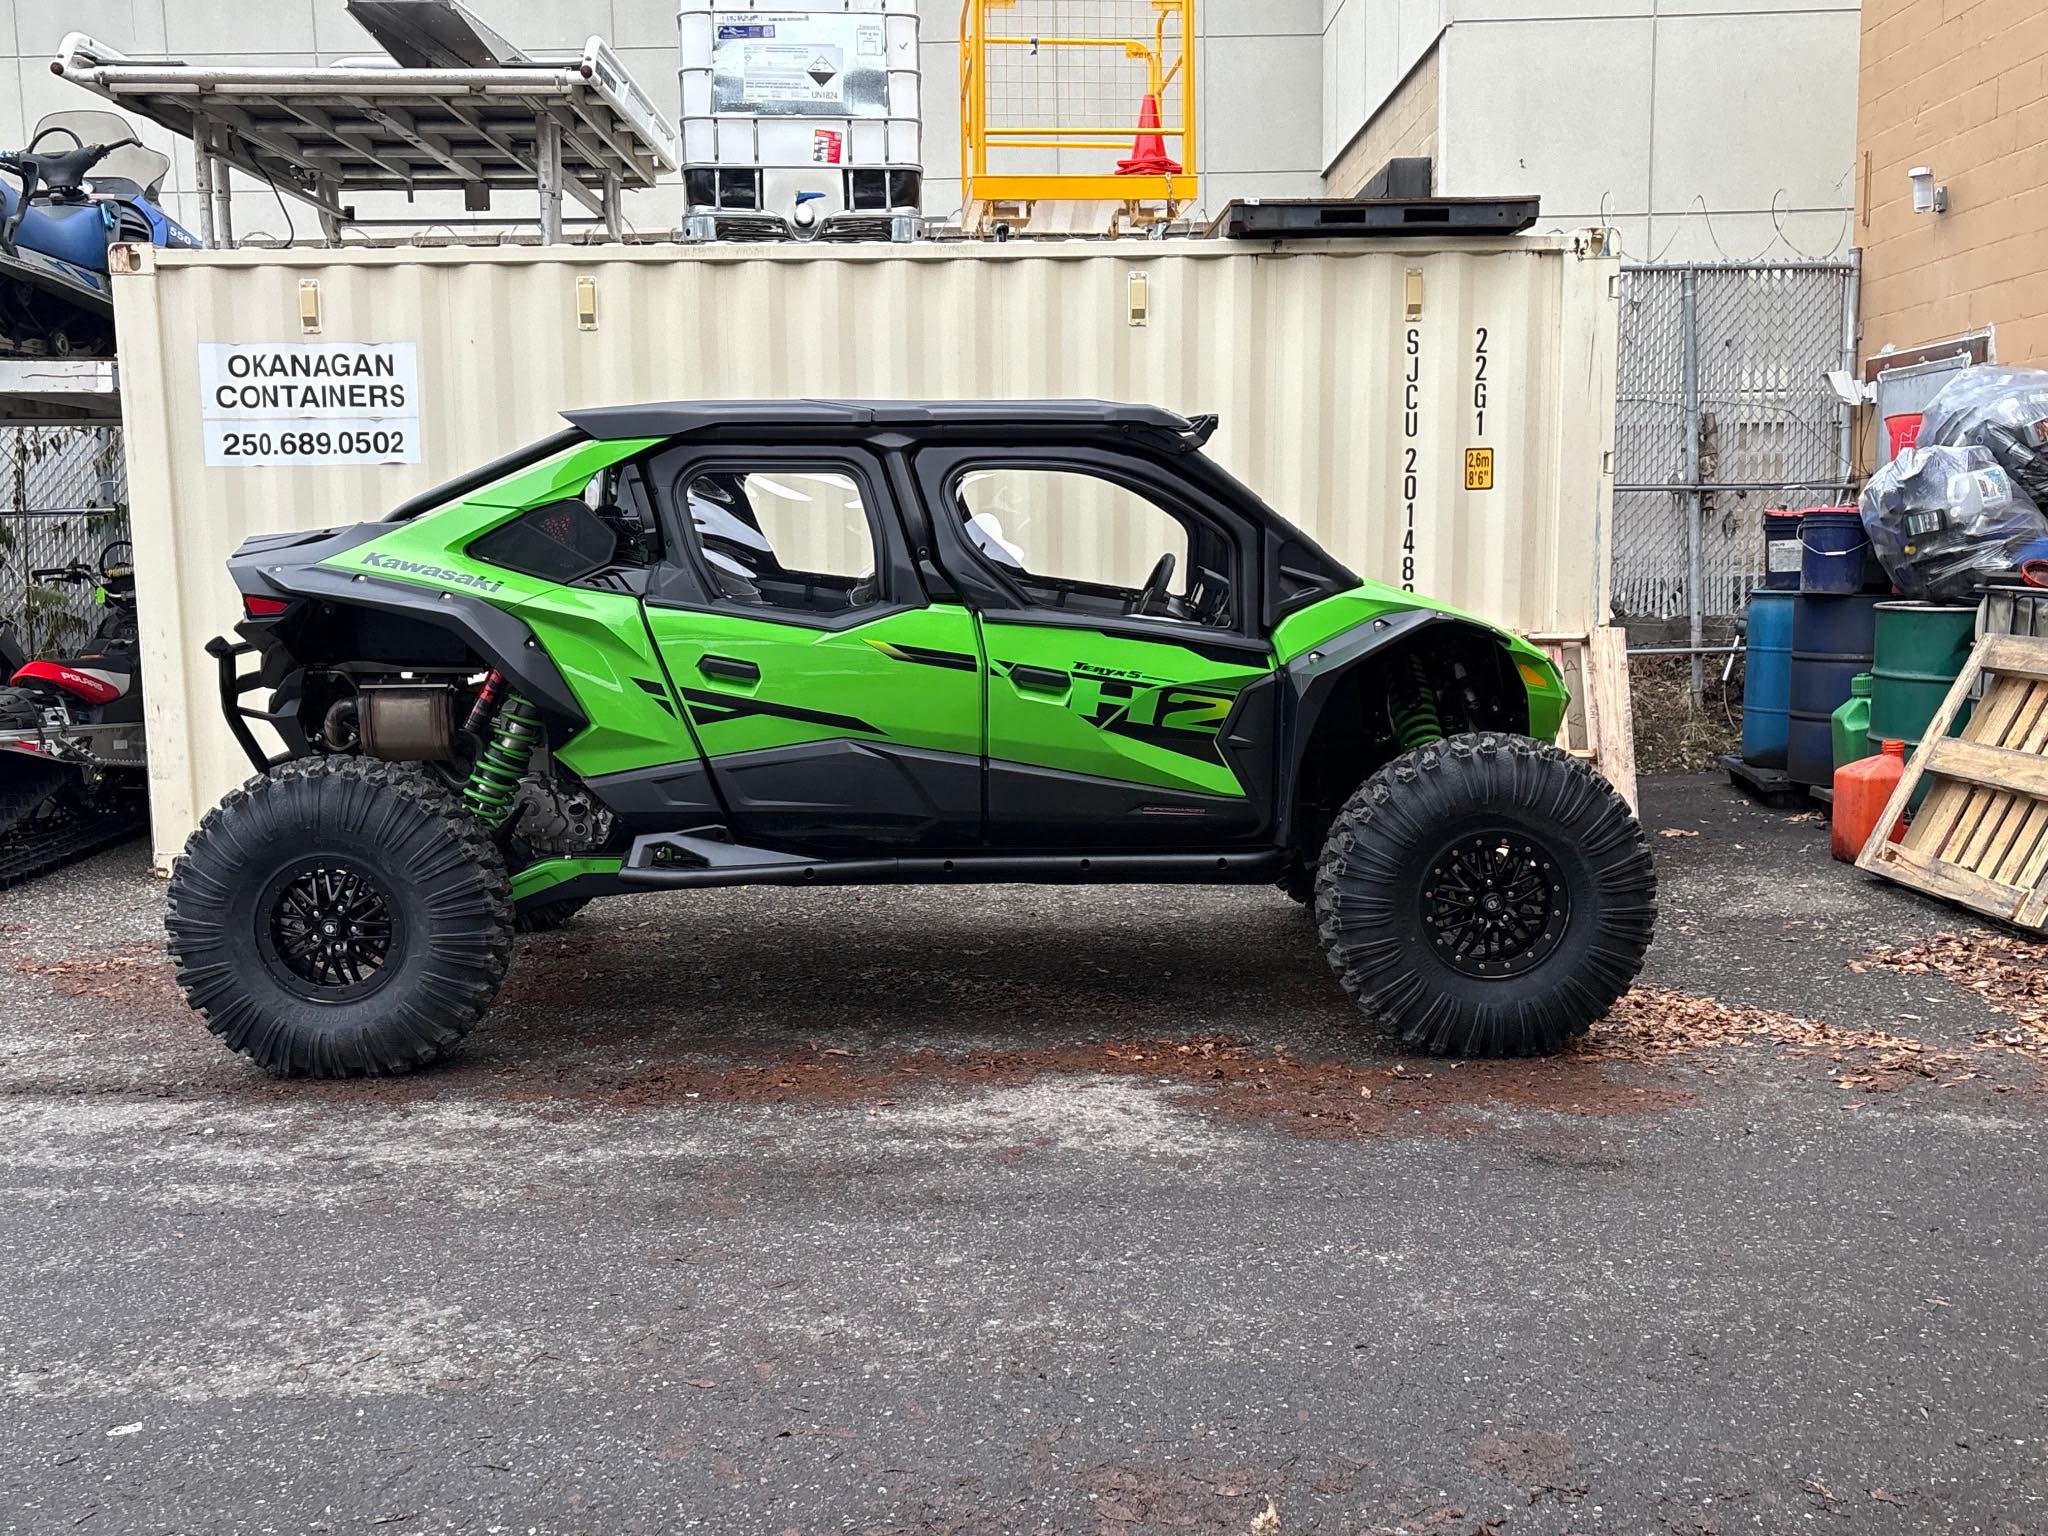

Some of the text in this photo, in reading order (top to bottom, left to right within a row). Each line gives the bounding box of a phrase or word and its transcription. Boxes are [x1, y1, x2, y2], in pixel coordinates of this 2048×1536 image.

[169, 226, 192, 245] 550
[227, 353, 394, 378] OKANAGAN
[1405, 329, 1419, 437] SJCU
[1474, 327, 1488, 436] 22G1
[215, 384, 405, 409] CONTAINERS
[223, 431, 404, 456] 250.689.0502
[1468, 452, 1490, 470] 2,6m
[1468, 470, 1489, 486] 8'6"
[360, 551, 505, 593] Kawasaki
[60, 671, 104, 692] POLARIS
